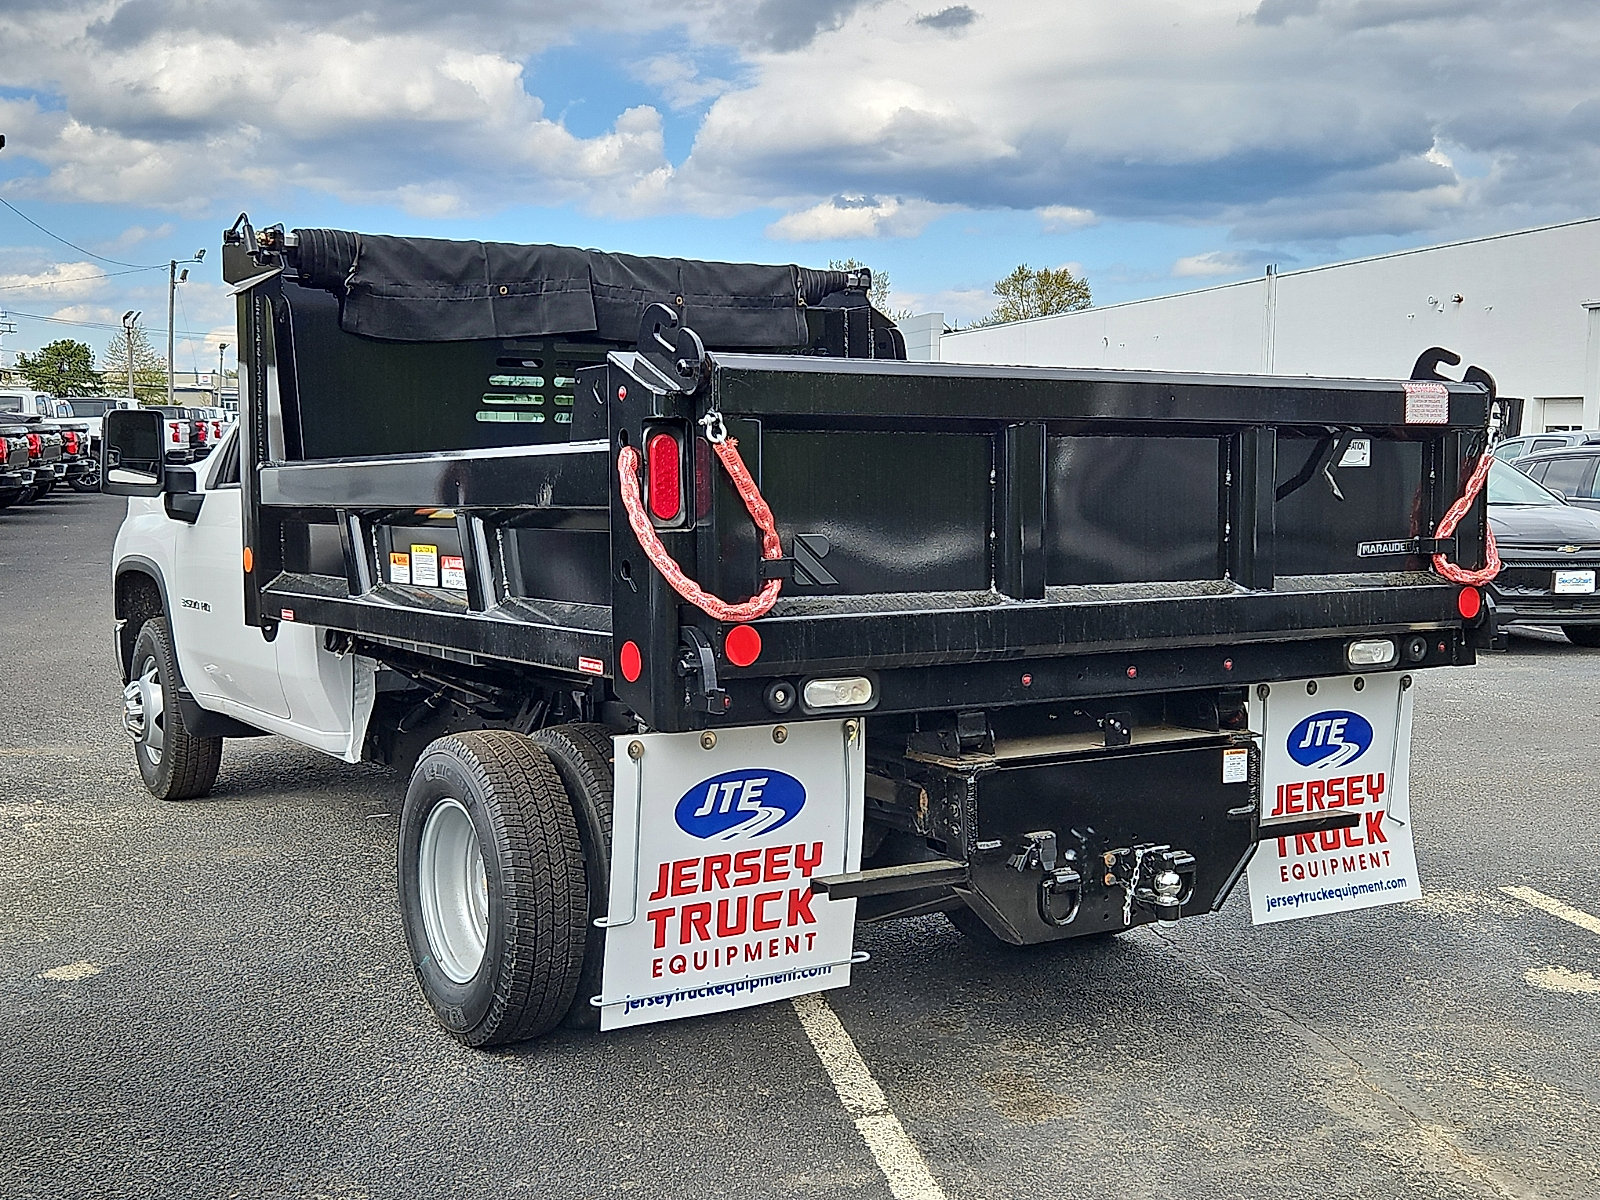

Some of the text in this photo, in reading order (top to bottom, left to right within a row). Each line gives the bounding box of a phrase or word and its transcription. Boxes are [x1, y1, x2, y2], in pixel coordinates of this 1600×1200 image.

[1299, 718, 1348, 748] JTE
[693, 777, 769, 817] JTE
[1271, 773, 1385, 816] JERSEY
[649, 841, 823, 901] JERSEY
[1280, 850, 1391, 882] EQUIPMENT
[1266, 878, 1407, 912] jerseytruckequipment.com
[647, 887, 817, 949] TRUCK
[652, 932, 817, 978] EQUIPMENT
